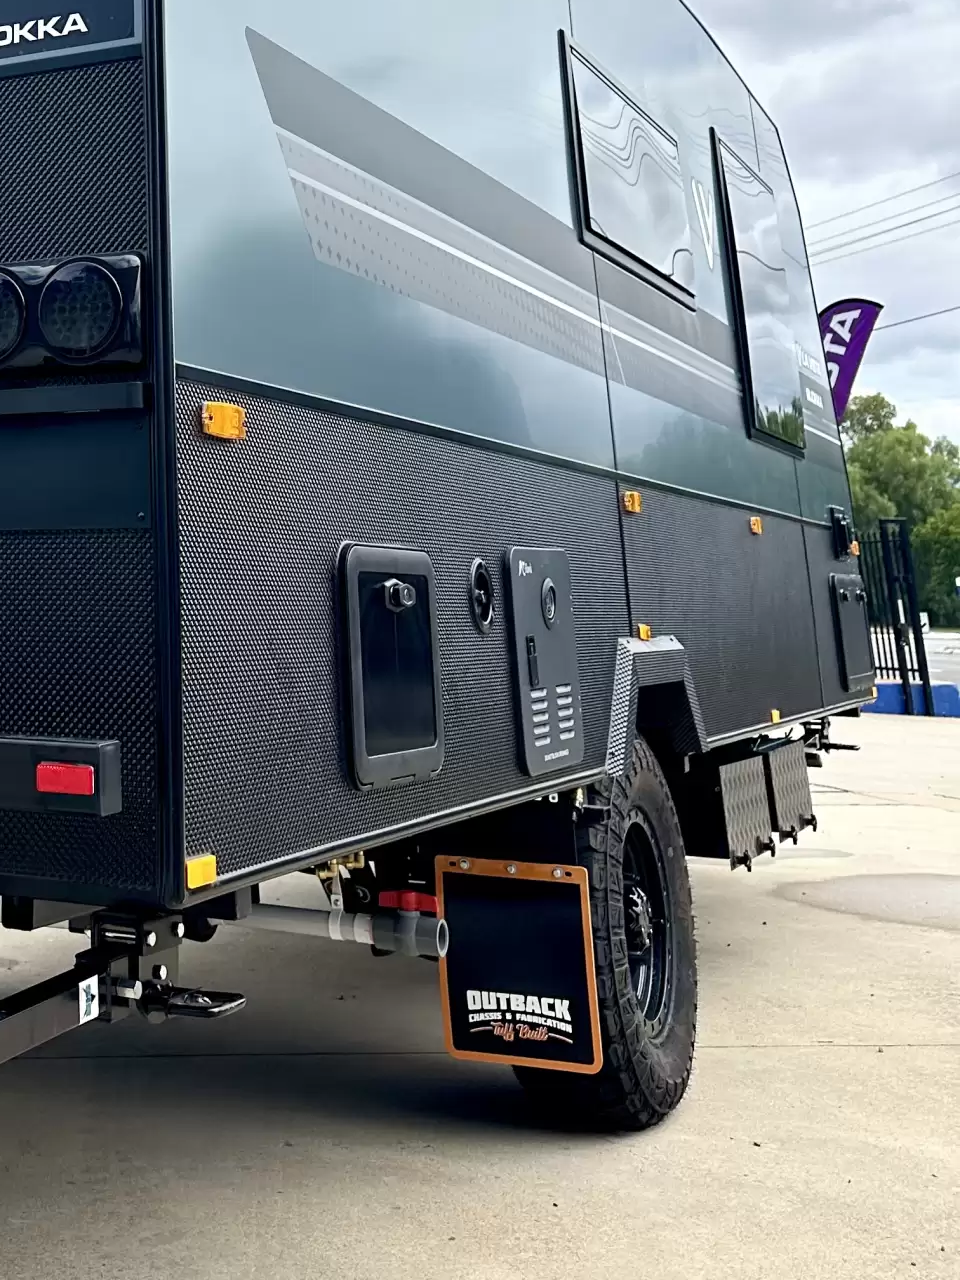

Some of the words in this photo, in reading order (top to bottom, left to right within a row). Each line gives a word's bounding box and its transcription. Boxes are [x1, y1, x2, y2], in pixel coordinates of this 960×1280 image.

[466, 989, 572, 1022] OUTBACK
[468, 1011, 503, 1023] CHASSIS
[515, 1013, 573, 1034] FABRICATION
[490, 1021, 515, 1042] Tuff
[515, 1023, 549, 1041] Built
